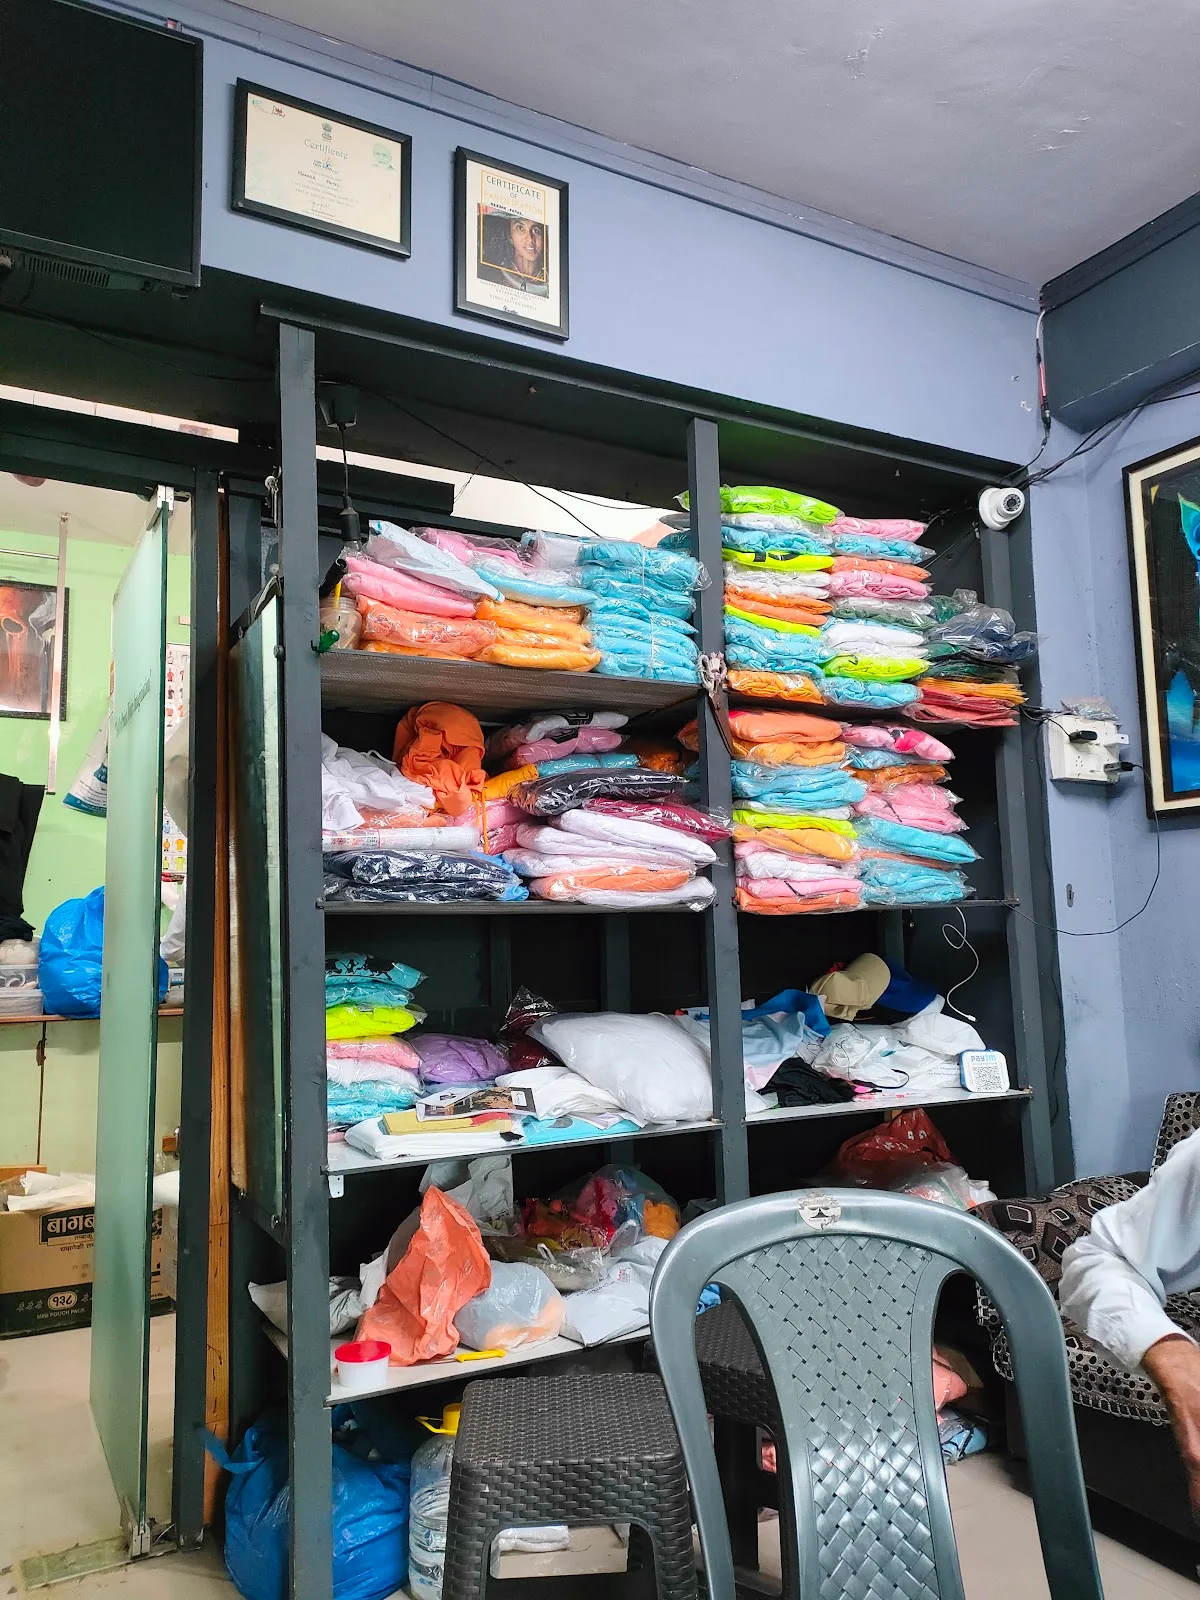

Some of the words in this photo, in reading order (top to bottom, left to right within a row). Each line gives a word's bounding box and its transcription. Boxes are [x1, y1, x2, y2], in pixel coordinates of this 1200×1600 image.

[304, 139, 348, 160] Certificate
[486, 176, 541, 199] CERTIFICATE
[50, 1309, 70, 1318] POUCH
[71, 1307, 86, 1315] PACK
